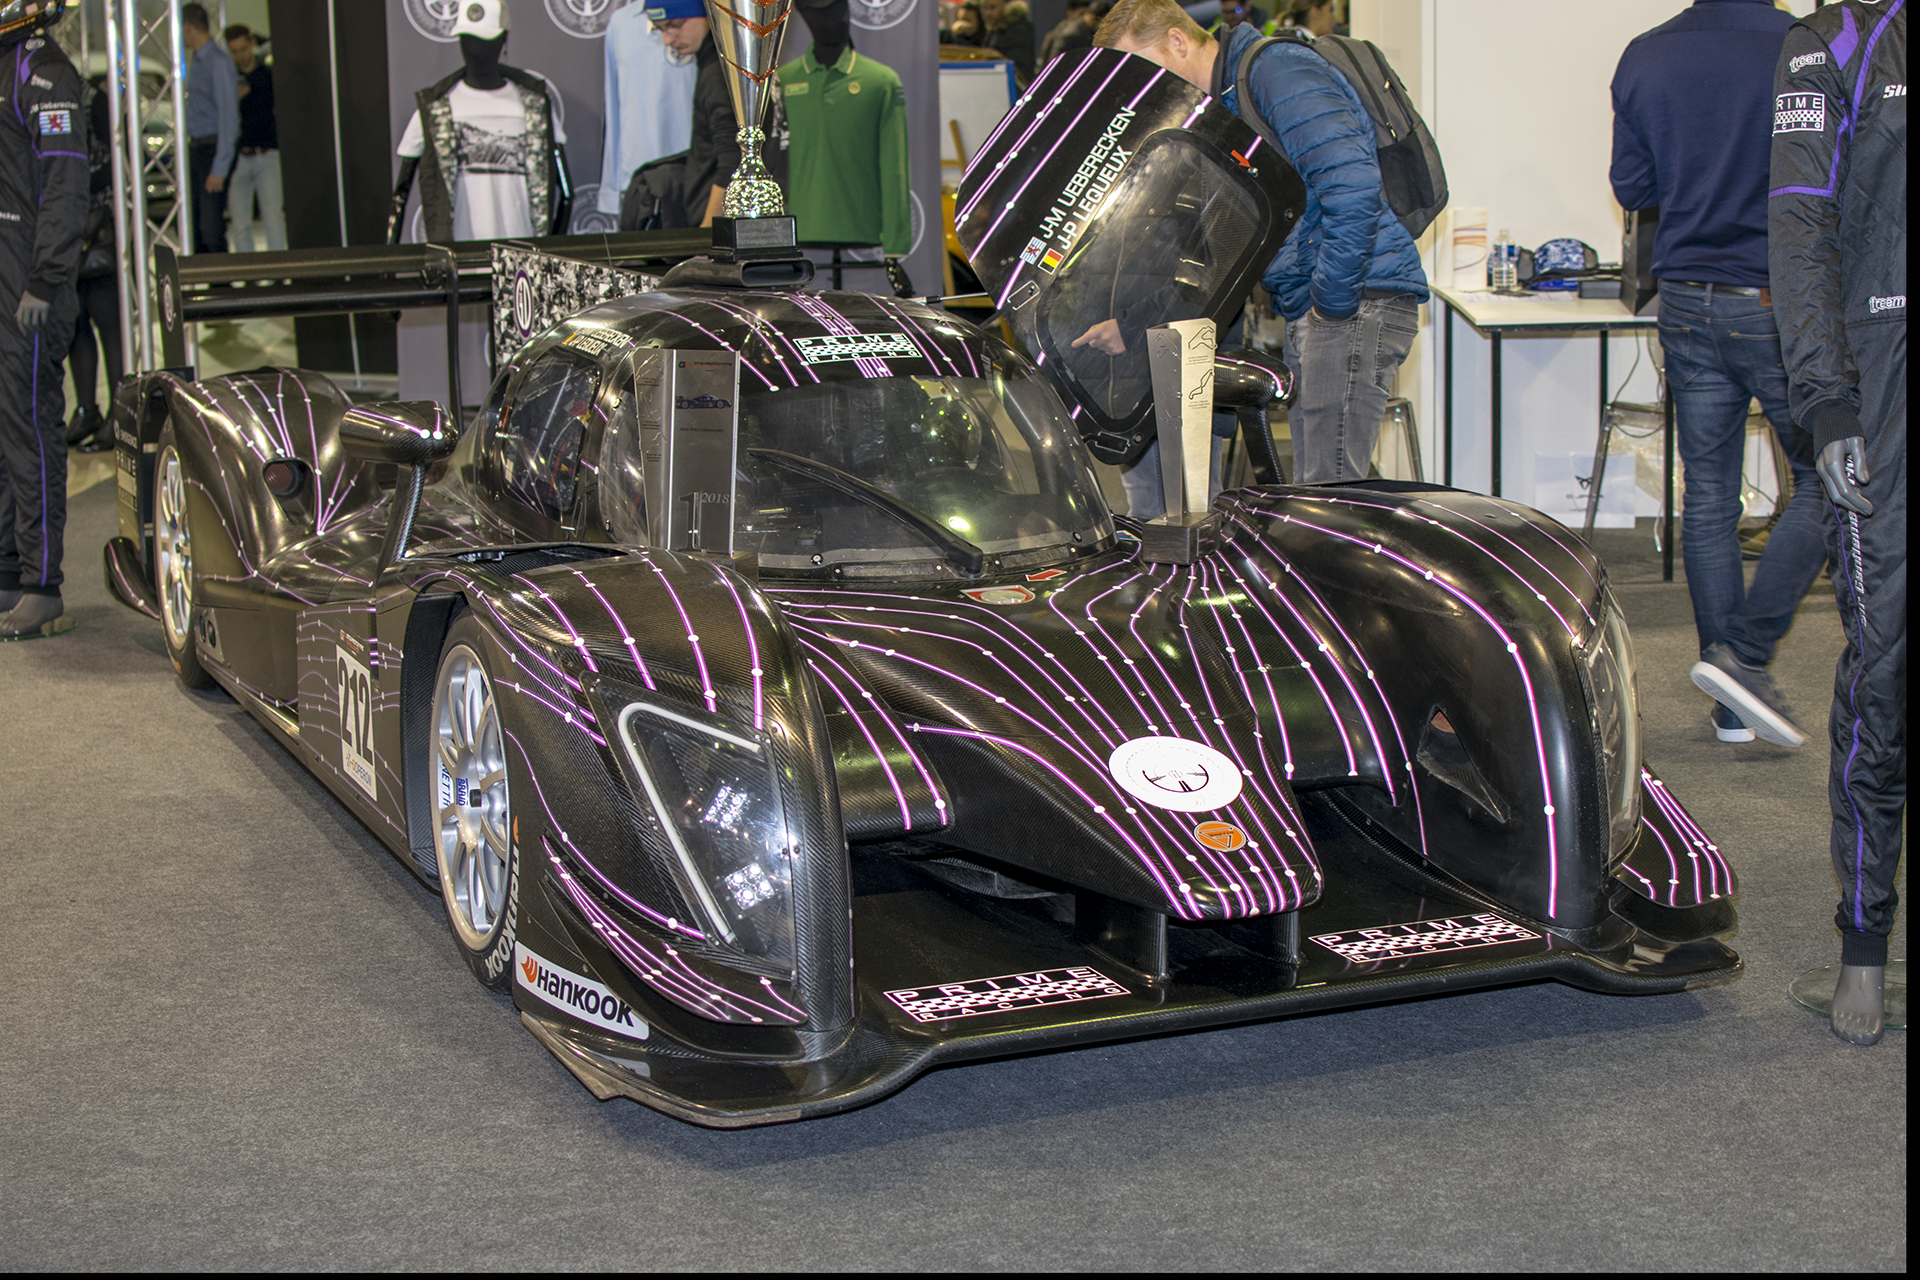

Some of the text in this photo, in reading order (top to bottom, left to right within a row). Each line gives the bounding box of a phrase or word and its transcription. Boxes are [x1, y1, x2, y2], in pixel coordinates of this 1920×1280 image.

[1777, 97, 1822, 110] RIME
[1775, 122, 1821, 130] CING
[1039, 106, 1136, 239] J-M UEBERECKEN
[1057, 145, 1133, 250] J-P LEQUEUX
[1869, 295, 1906, 313] freem
[798, 334, 908, 348] PRIME
[809, 350, 918, 363] RACING
[700, 492, 729, 504] 2018
[338, 656, 373, 766] 212
[457, 778, 467, 806] BRAID
[1317, 913, 1505, 946] PRIME
[1351, 931, 1532, 961] RACING
[893, 968, 1097, 1002] PRIME
[920, 987, 1122, 1020] RACING
